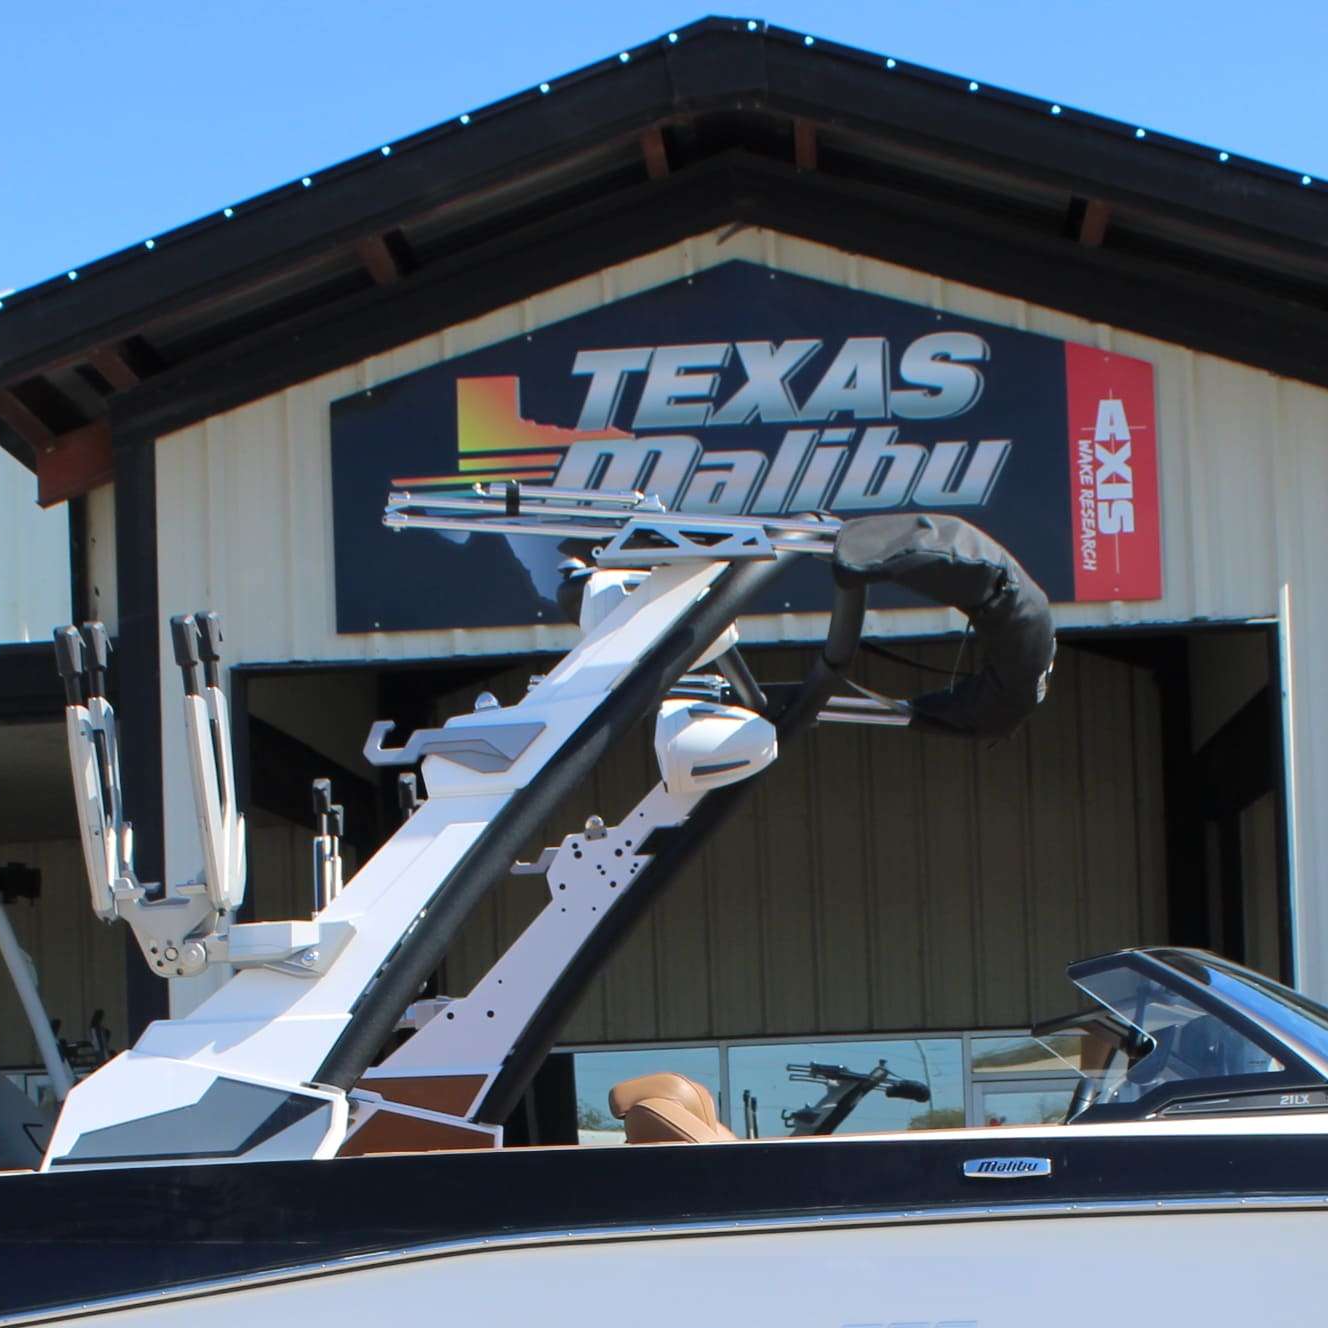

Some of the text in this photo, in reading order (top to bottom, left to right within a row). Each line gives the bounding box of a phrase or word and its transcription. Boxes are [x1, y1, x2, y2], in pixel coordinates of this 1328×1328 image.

[571, 331, 992, 432] TEXAS
[543, 426, 1013, 515] Malibu
[1078, 439, 1097, 571] WAKE RESEARCH
[1093, 399, 1135, 534] AXIS
[1279, 1094, 1310, 1105] 21LX
[976, 1159, 1040, 1173] Malibu
